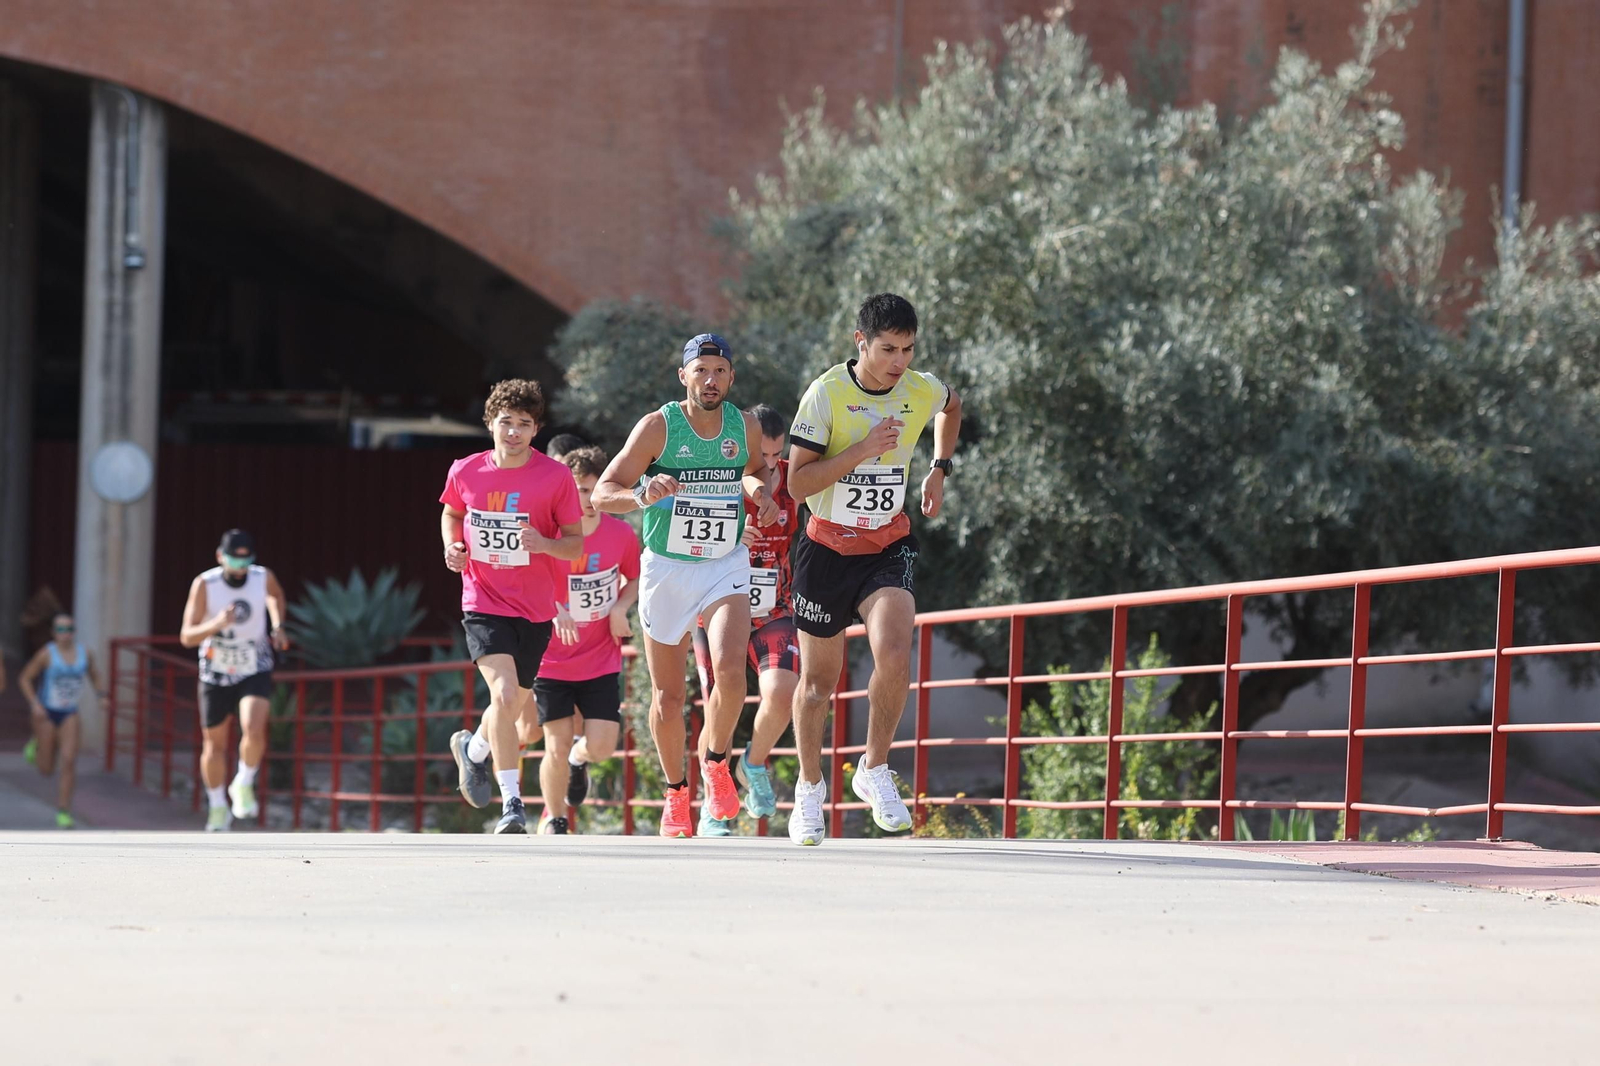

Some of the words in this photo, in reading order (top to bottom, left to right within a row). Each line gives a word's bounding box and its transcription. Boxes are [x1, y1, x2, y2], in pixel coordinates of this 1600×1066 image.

[678, 469, 736, 481] ATLETISMO
[840, 474, 872, 485] UMA
[487, 491, 520, 513] WE
[845, 487, 894, 511] 238
[677, 506, 706, 517] UMA
[472, 518, 497, 528] UMA
[682, 519, 726, 542] 131
[857, 518, 870, 527] WE
[479, 530, 520, 551] 350
[570, 553, 601, 574] WE
[572, 581, 597, 591] UMA
[579, 585, 613, 609] 351
[796, 592, 825, 613] TRAIL
[797, 607, 831, 623] SANTO
